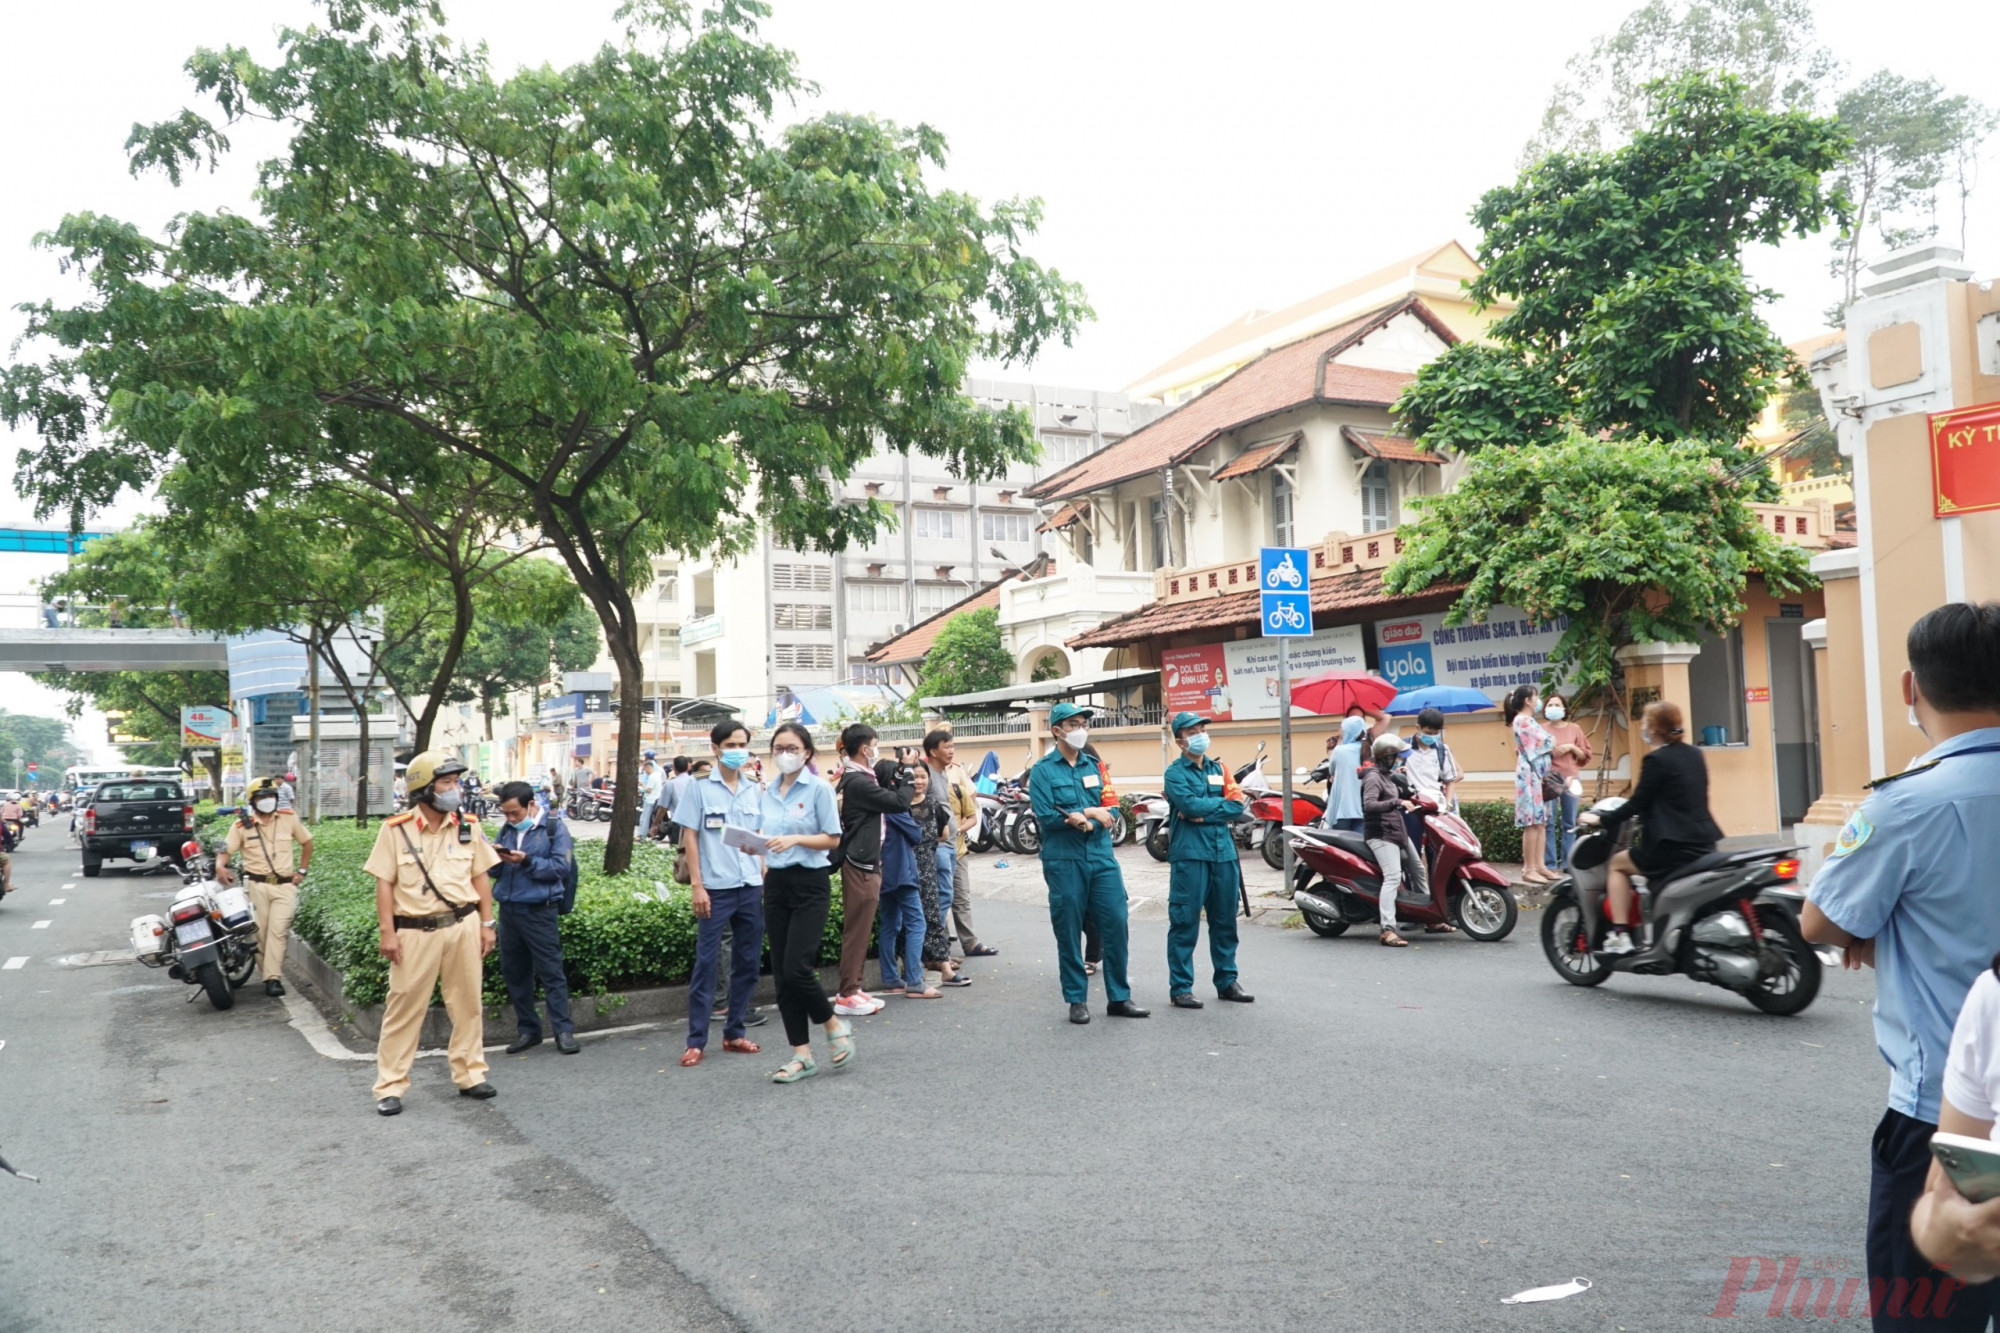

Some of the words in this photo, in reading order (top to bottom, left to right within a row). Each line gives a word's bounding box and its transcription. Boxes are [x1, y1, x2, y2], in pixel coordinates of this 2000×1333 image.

[1948, 426, 1976, 448] KỲ
[1982, 424, 2000, 442] T
[1384, 627, 1403, 641] giáo
[1404, 625, 1420, 638] dục
[1433, 624, 1456, 646] CỔNG
[1492, 620, 1519, 642] SẠCH,
[1193, 663, 1209, 673] IELTS
[1385, 651, 1427, 684] yola
[1499, 652, 1510, 668] khi
[1197, 674, 1209, 685] LỰC
[190, 713, 204, 721] 48
